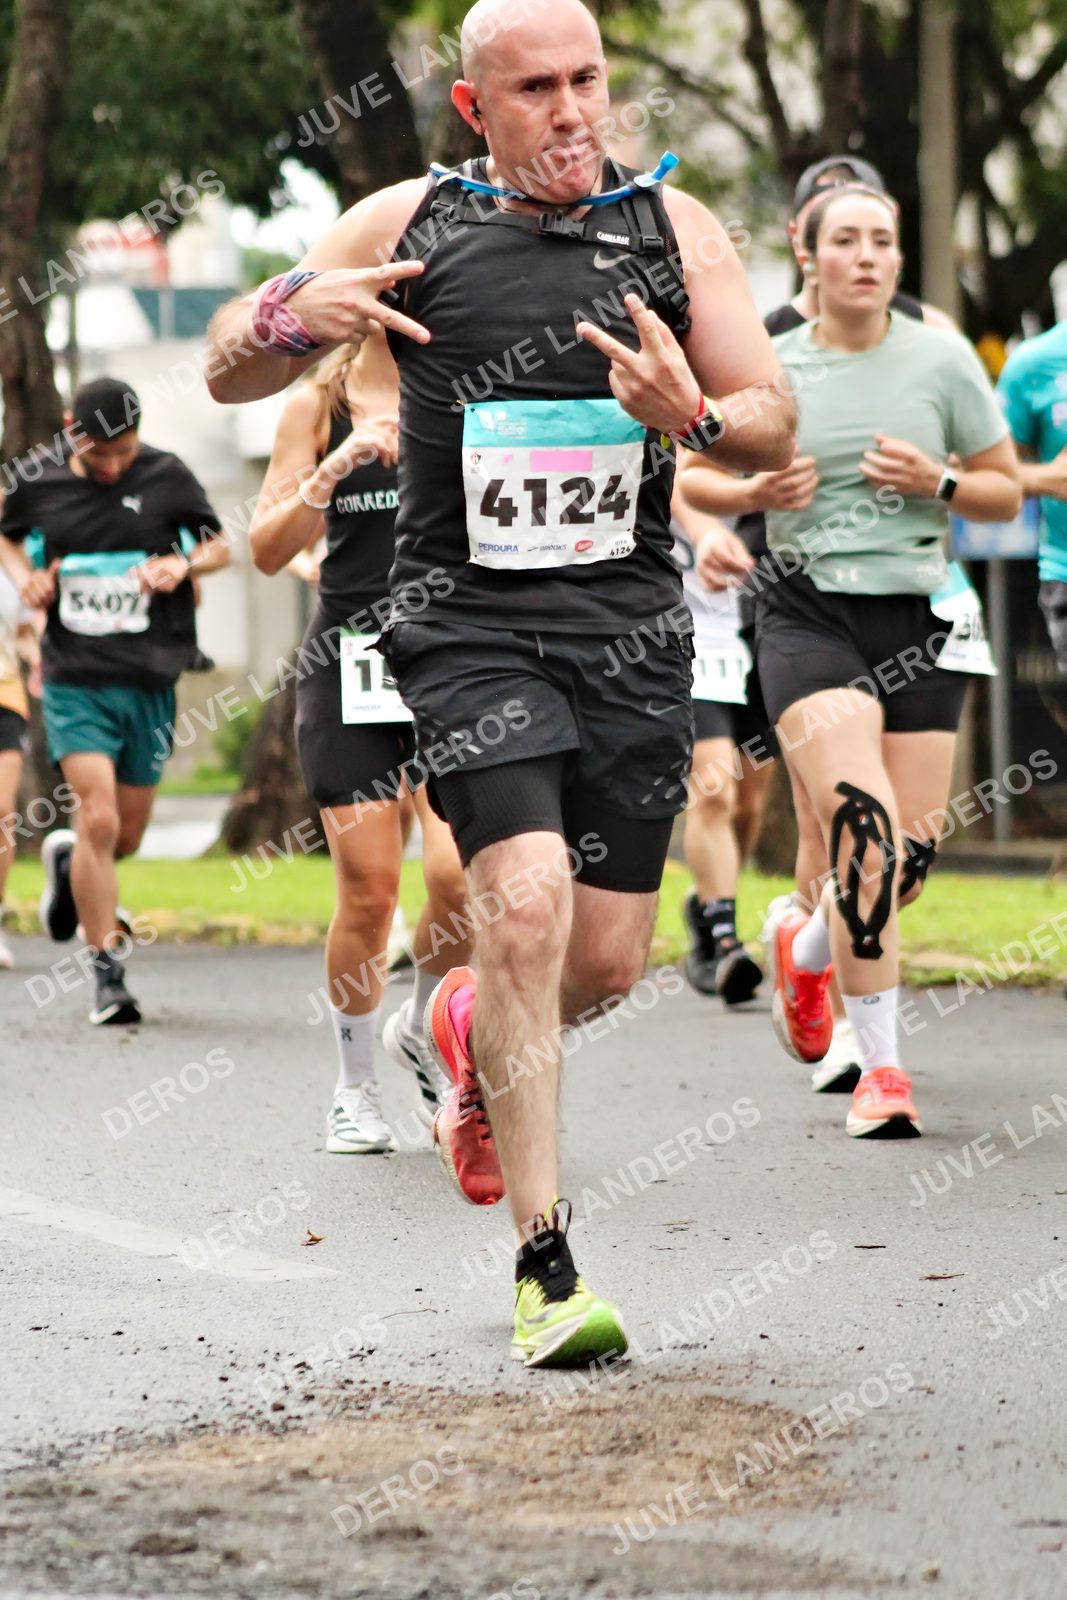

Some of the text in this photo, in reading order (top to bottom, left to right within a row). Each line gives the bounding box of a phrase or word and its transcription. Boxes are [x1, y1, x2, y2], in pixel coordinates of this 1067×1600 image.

[480, 474, 632, 527] 4124
[478, 543, 519, 553] PERDURA
[610, 546, 631, 557] 4124
